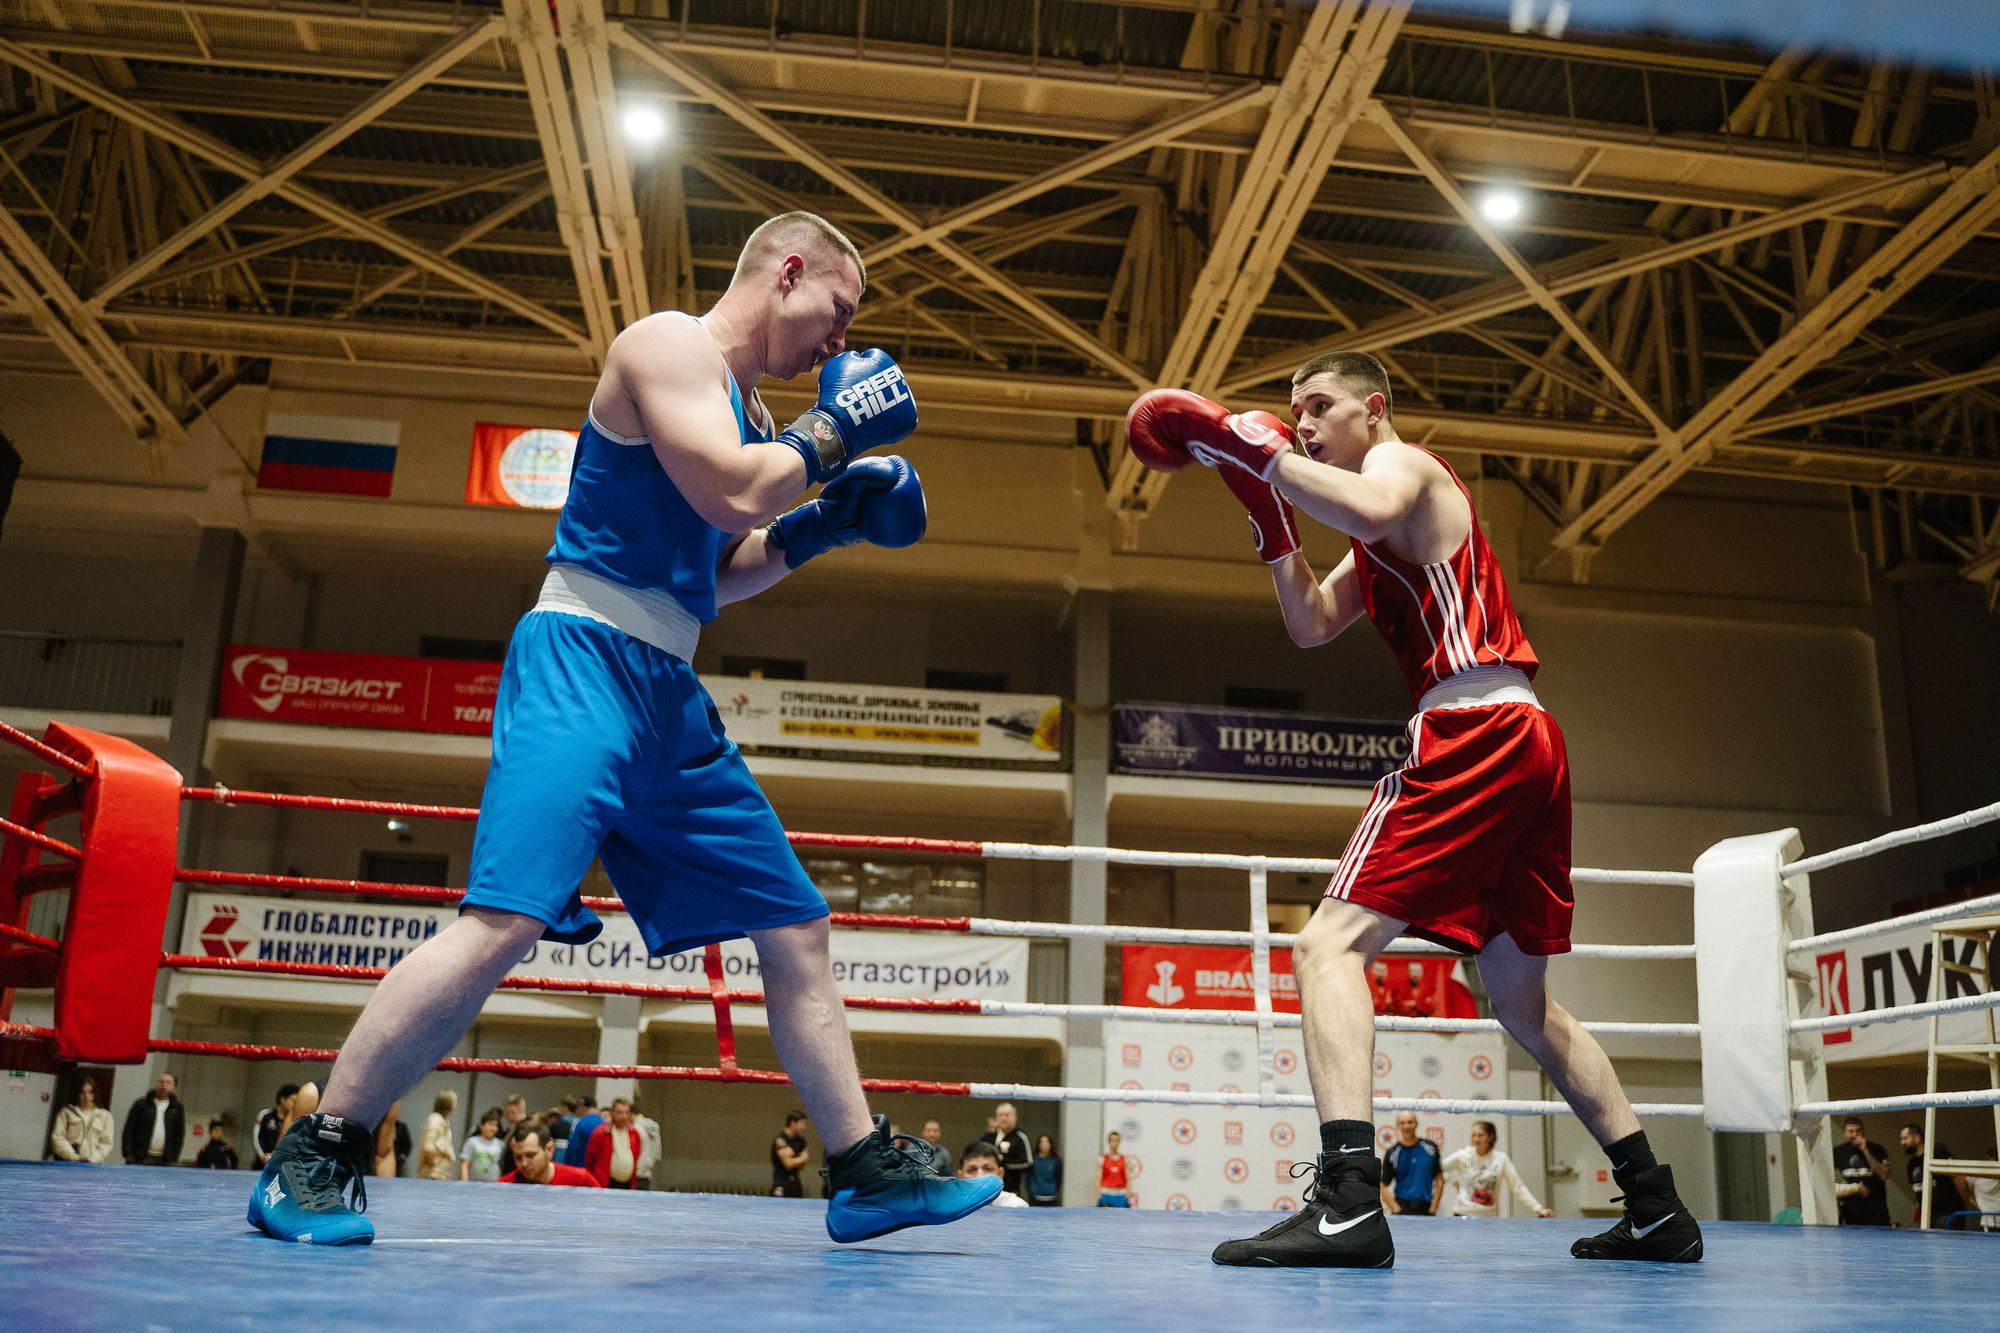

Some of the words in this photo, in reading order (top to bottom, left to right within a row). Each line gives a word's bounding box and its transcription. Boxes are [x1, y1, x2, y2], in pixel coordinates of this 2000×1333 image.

[836, 364, 905, 408] GREEN
[846, 383, 909, 426] HILL
[259, 672, 403, 700] СВЯЗИСТ
[263, 908, 439, 940] ГЛОБАЛСТРОЙ
[258, 939, 416, 969] ИНЖИНИРИ
